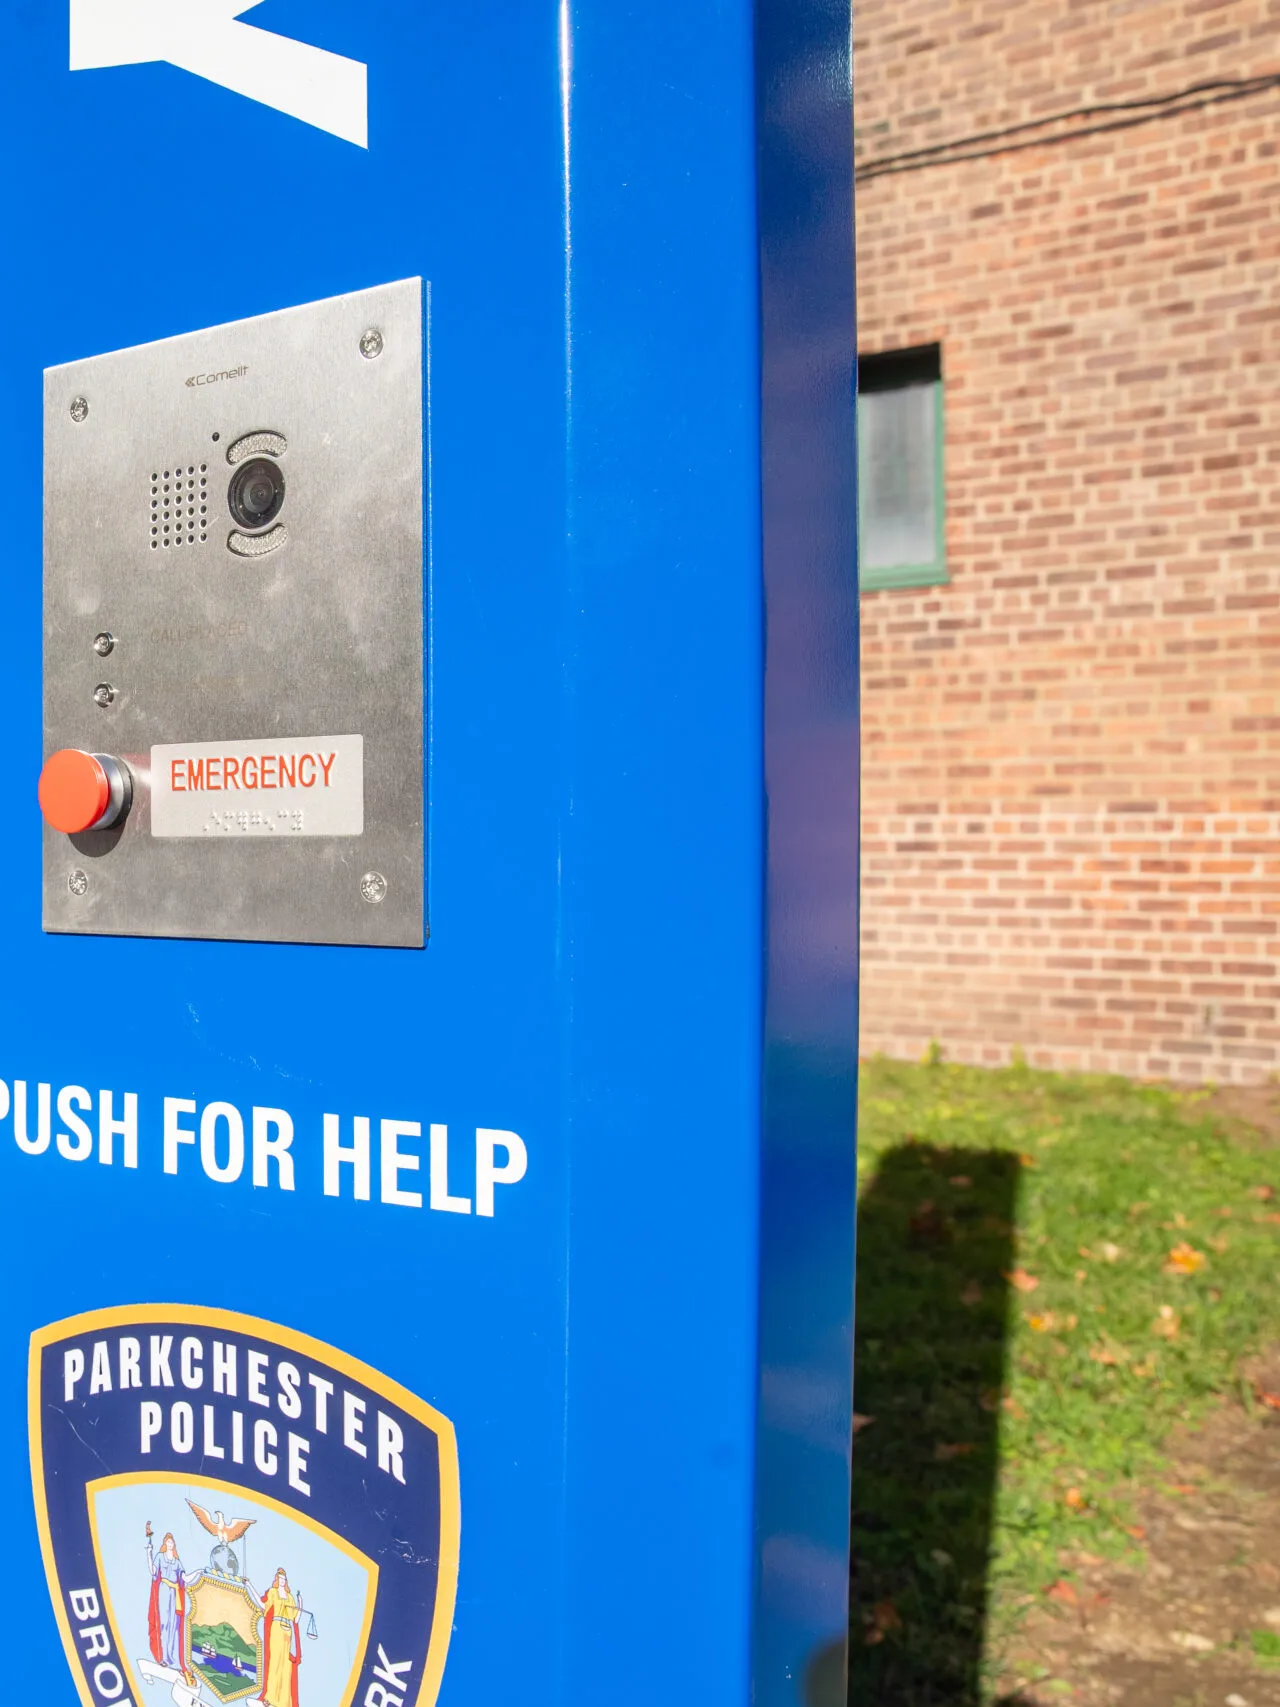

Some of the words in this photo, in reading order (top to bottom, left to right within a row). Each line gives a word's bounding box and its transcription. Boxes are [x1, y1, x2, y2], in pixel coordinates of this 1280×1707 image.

[171, 753, 337, 791] EMERGENCY
[163, 1097, 295, 1191] FOR
[323, 1113, 528, 1218] HELP
[64, 1335, 407, 1485] PARKCHESTER
[140, 1401, 311, 1498] POLICE
[69, 1588, 132, 1707] BRO
